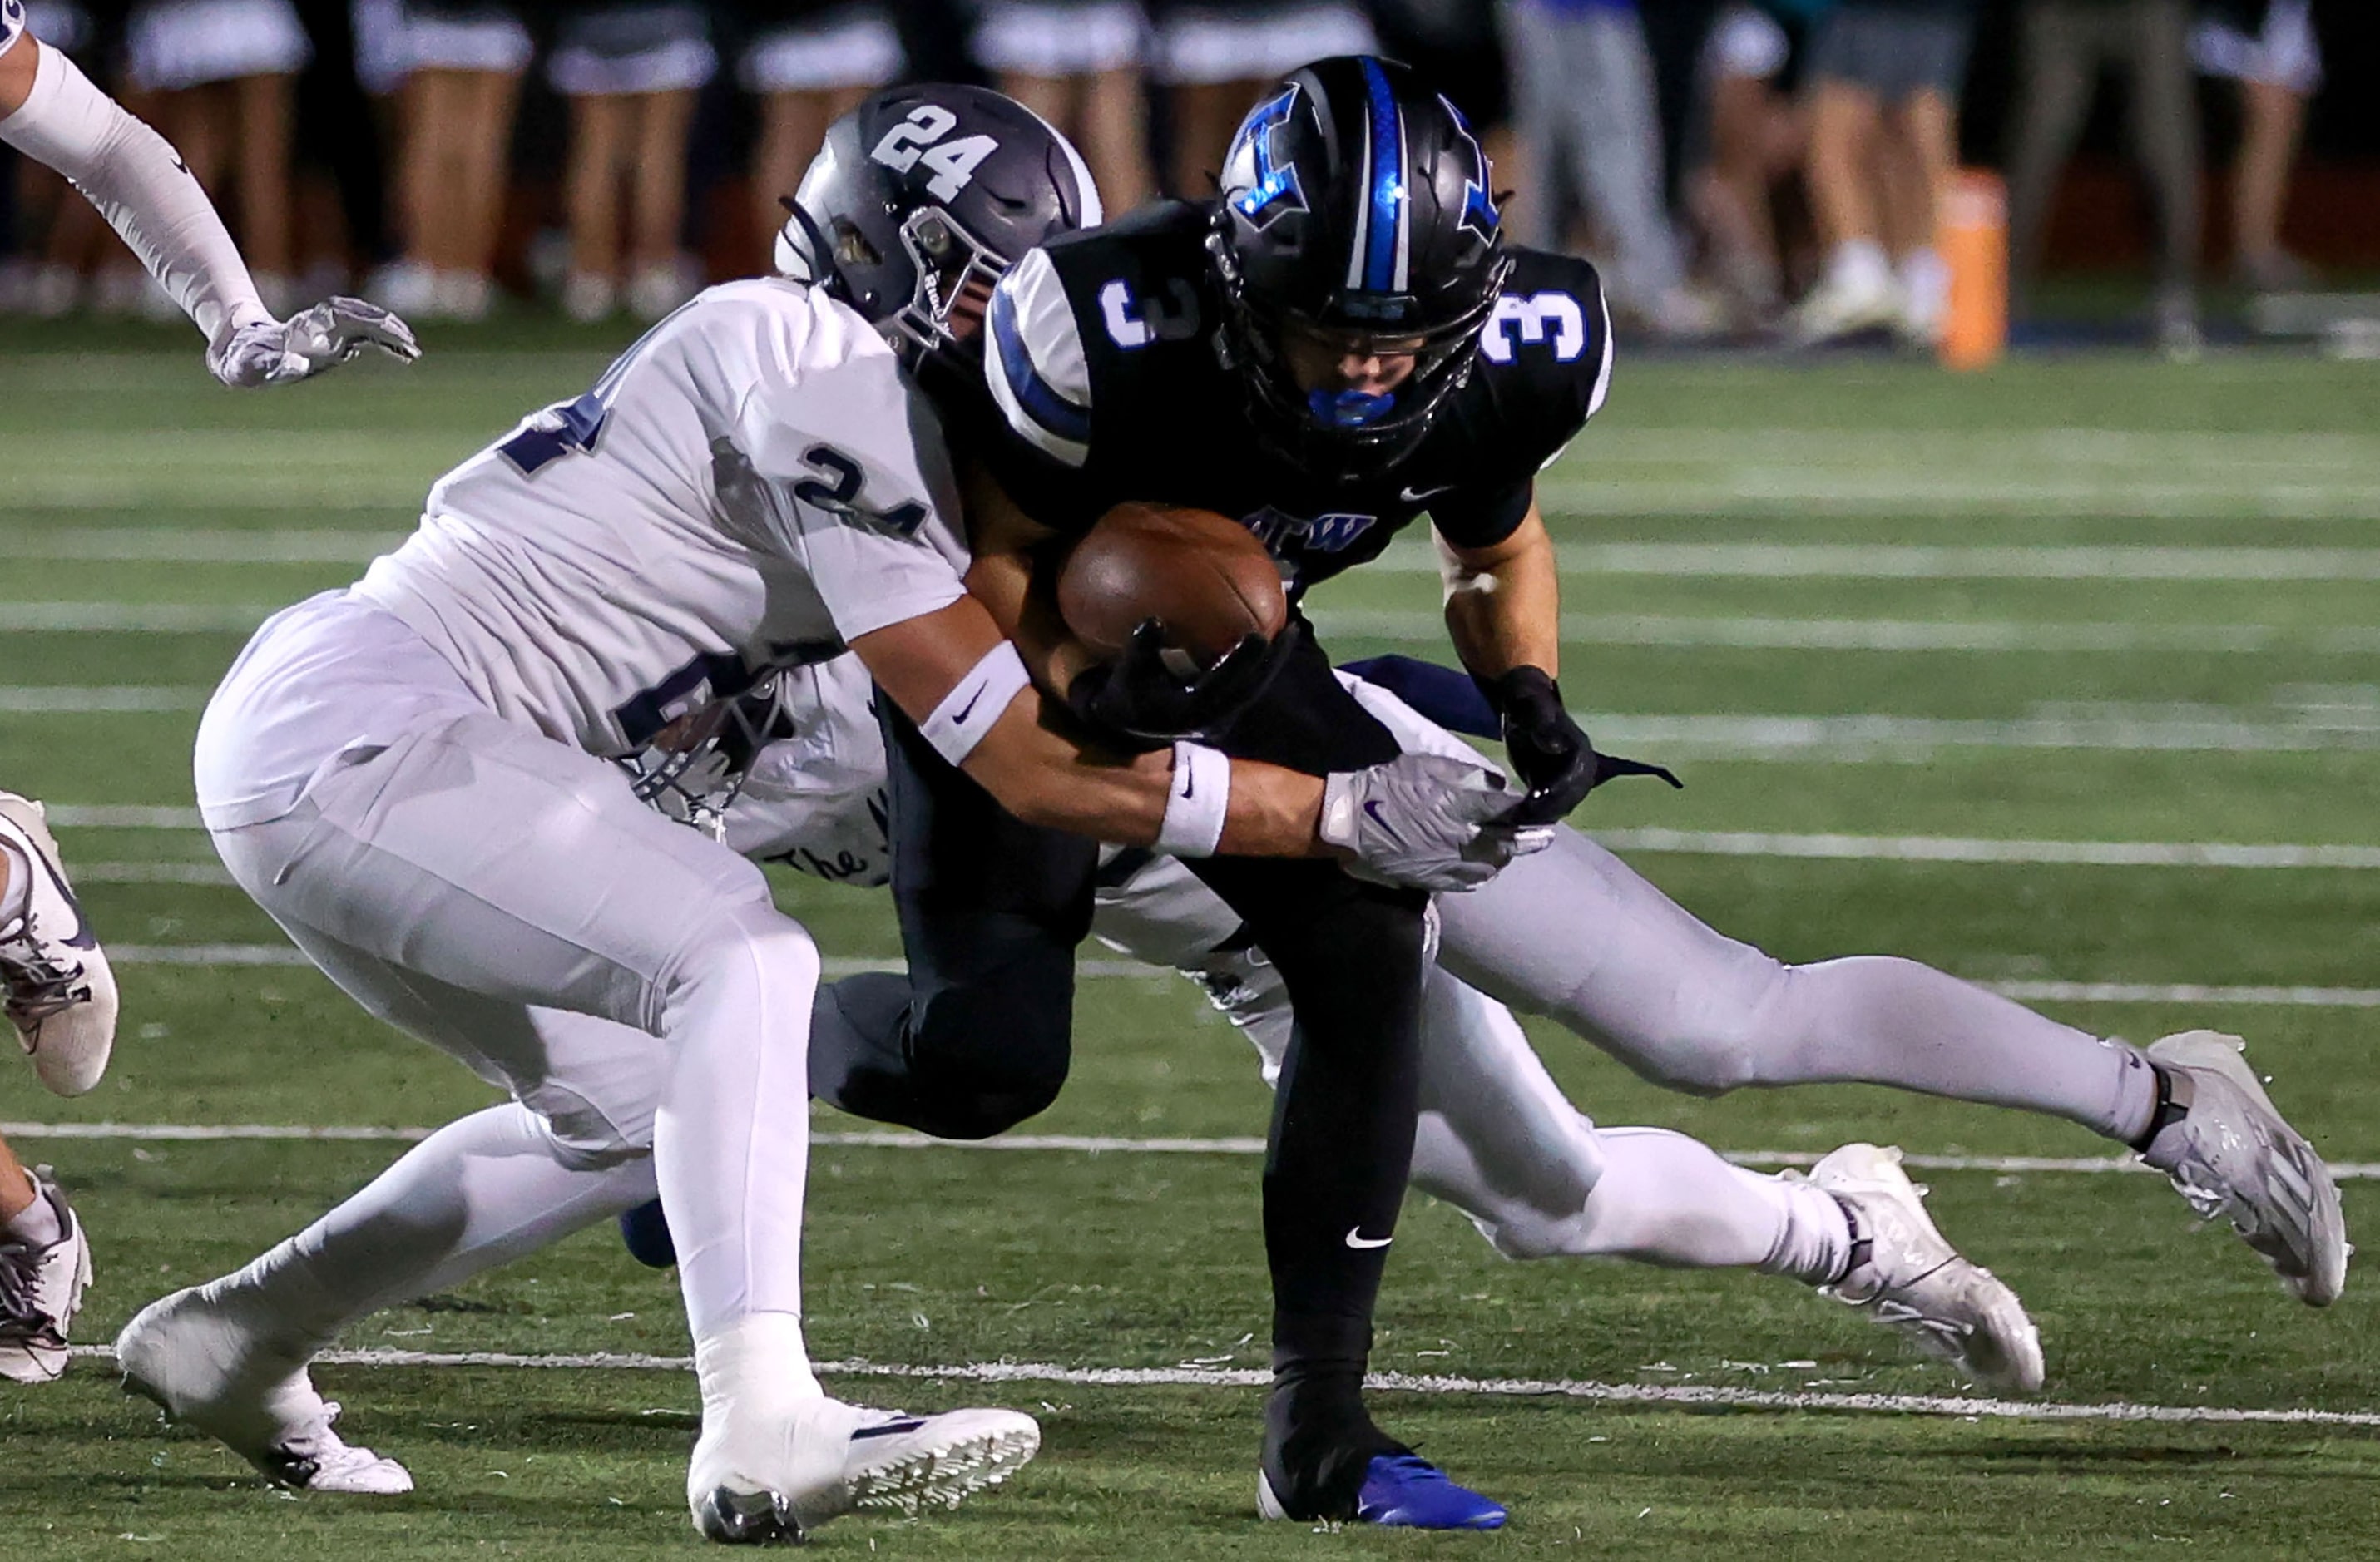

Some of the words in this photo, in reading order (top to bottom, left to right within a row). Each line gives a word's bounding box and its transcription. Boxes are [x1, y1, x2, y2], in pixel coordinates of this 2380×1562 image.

[870, 104, 999, 205] 24
[1096, 277, 1201, 349] 3
[1478, 289, 1588, 365] 3
[763, 847, 868, 881] The
